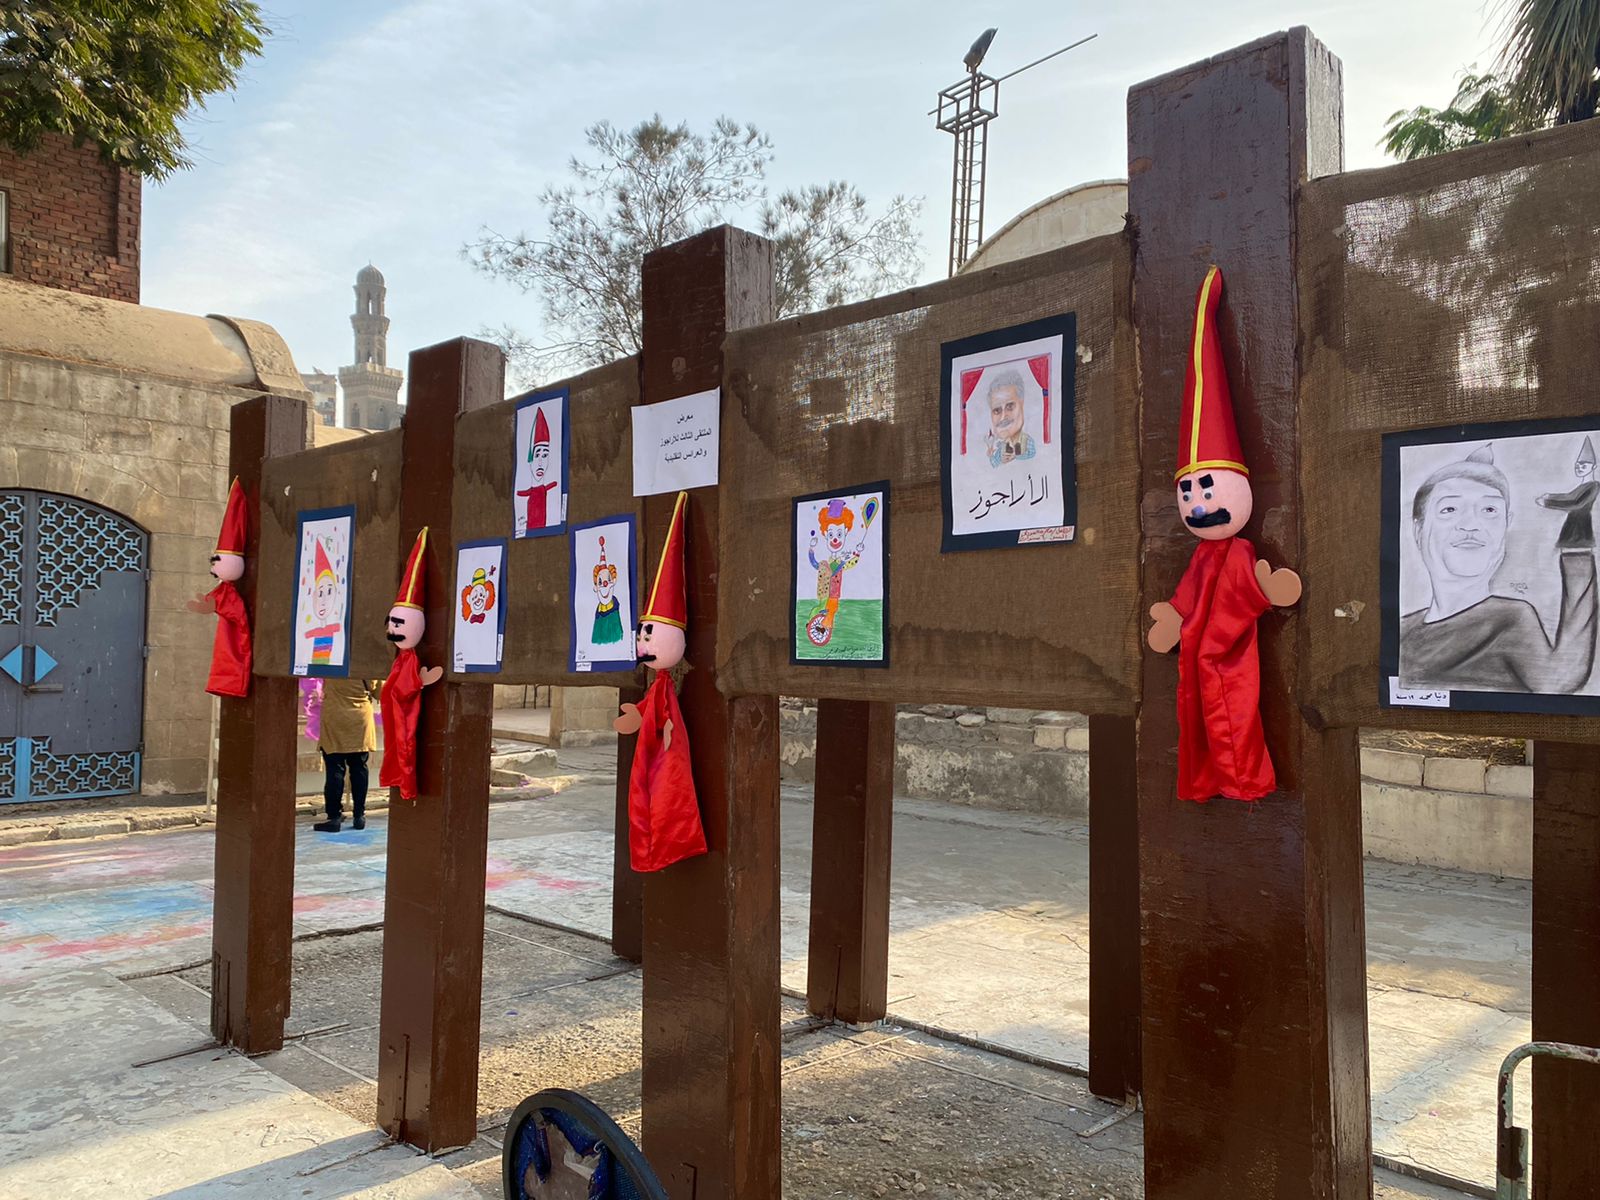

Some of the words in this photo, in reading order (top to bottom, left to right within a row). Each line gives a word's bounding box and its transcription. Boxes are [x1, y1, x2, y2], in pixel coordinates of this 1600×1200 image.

[677, 413, 694, 424] معرض
[680, 431, 693, 441] الثالث
[694, 428, 712, 441] الملتقى
[683, 448, 707, 460] والعرائس
[969, 474, 1049, 520] الأراجوز
